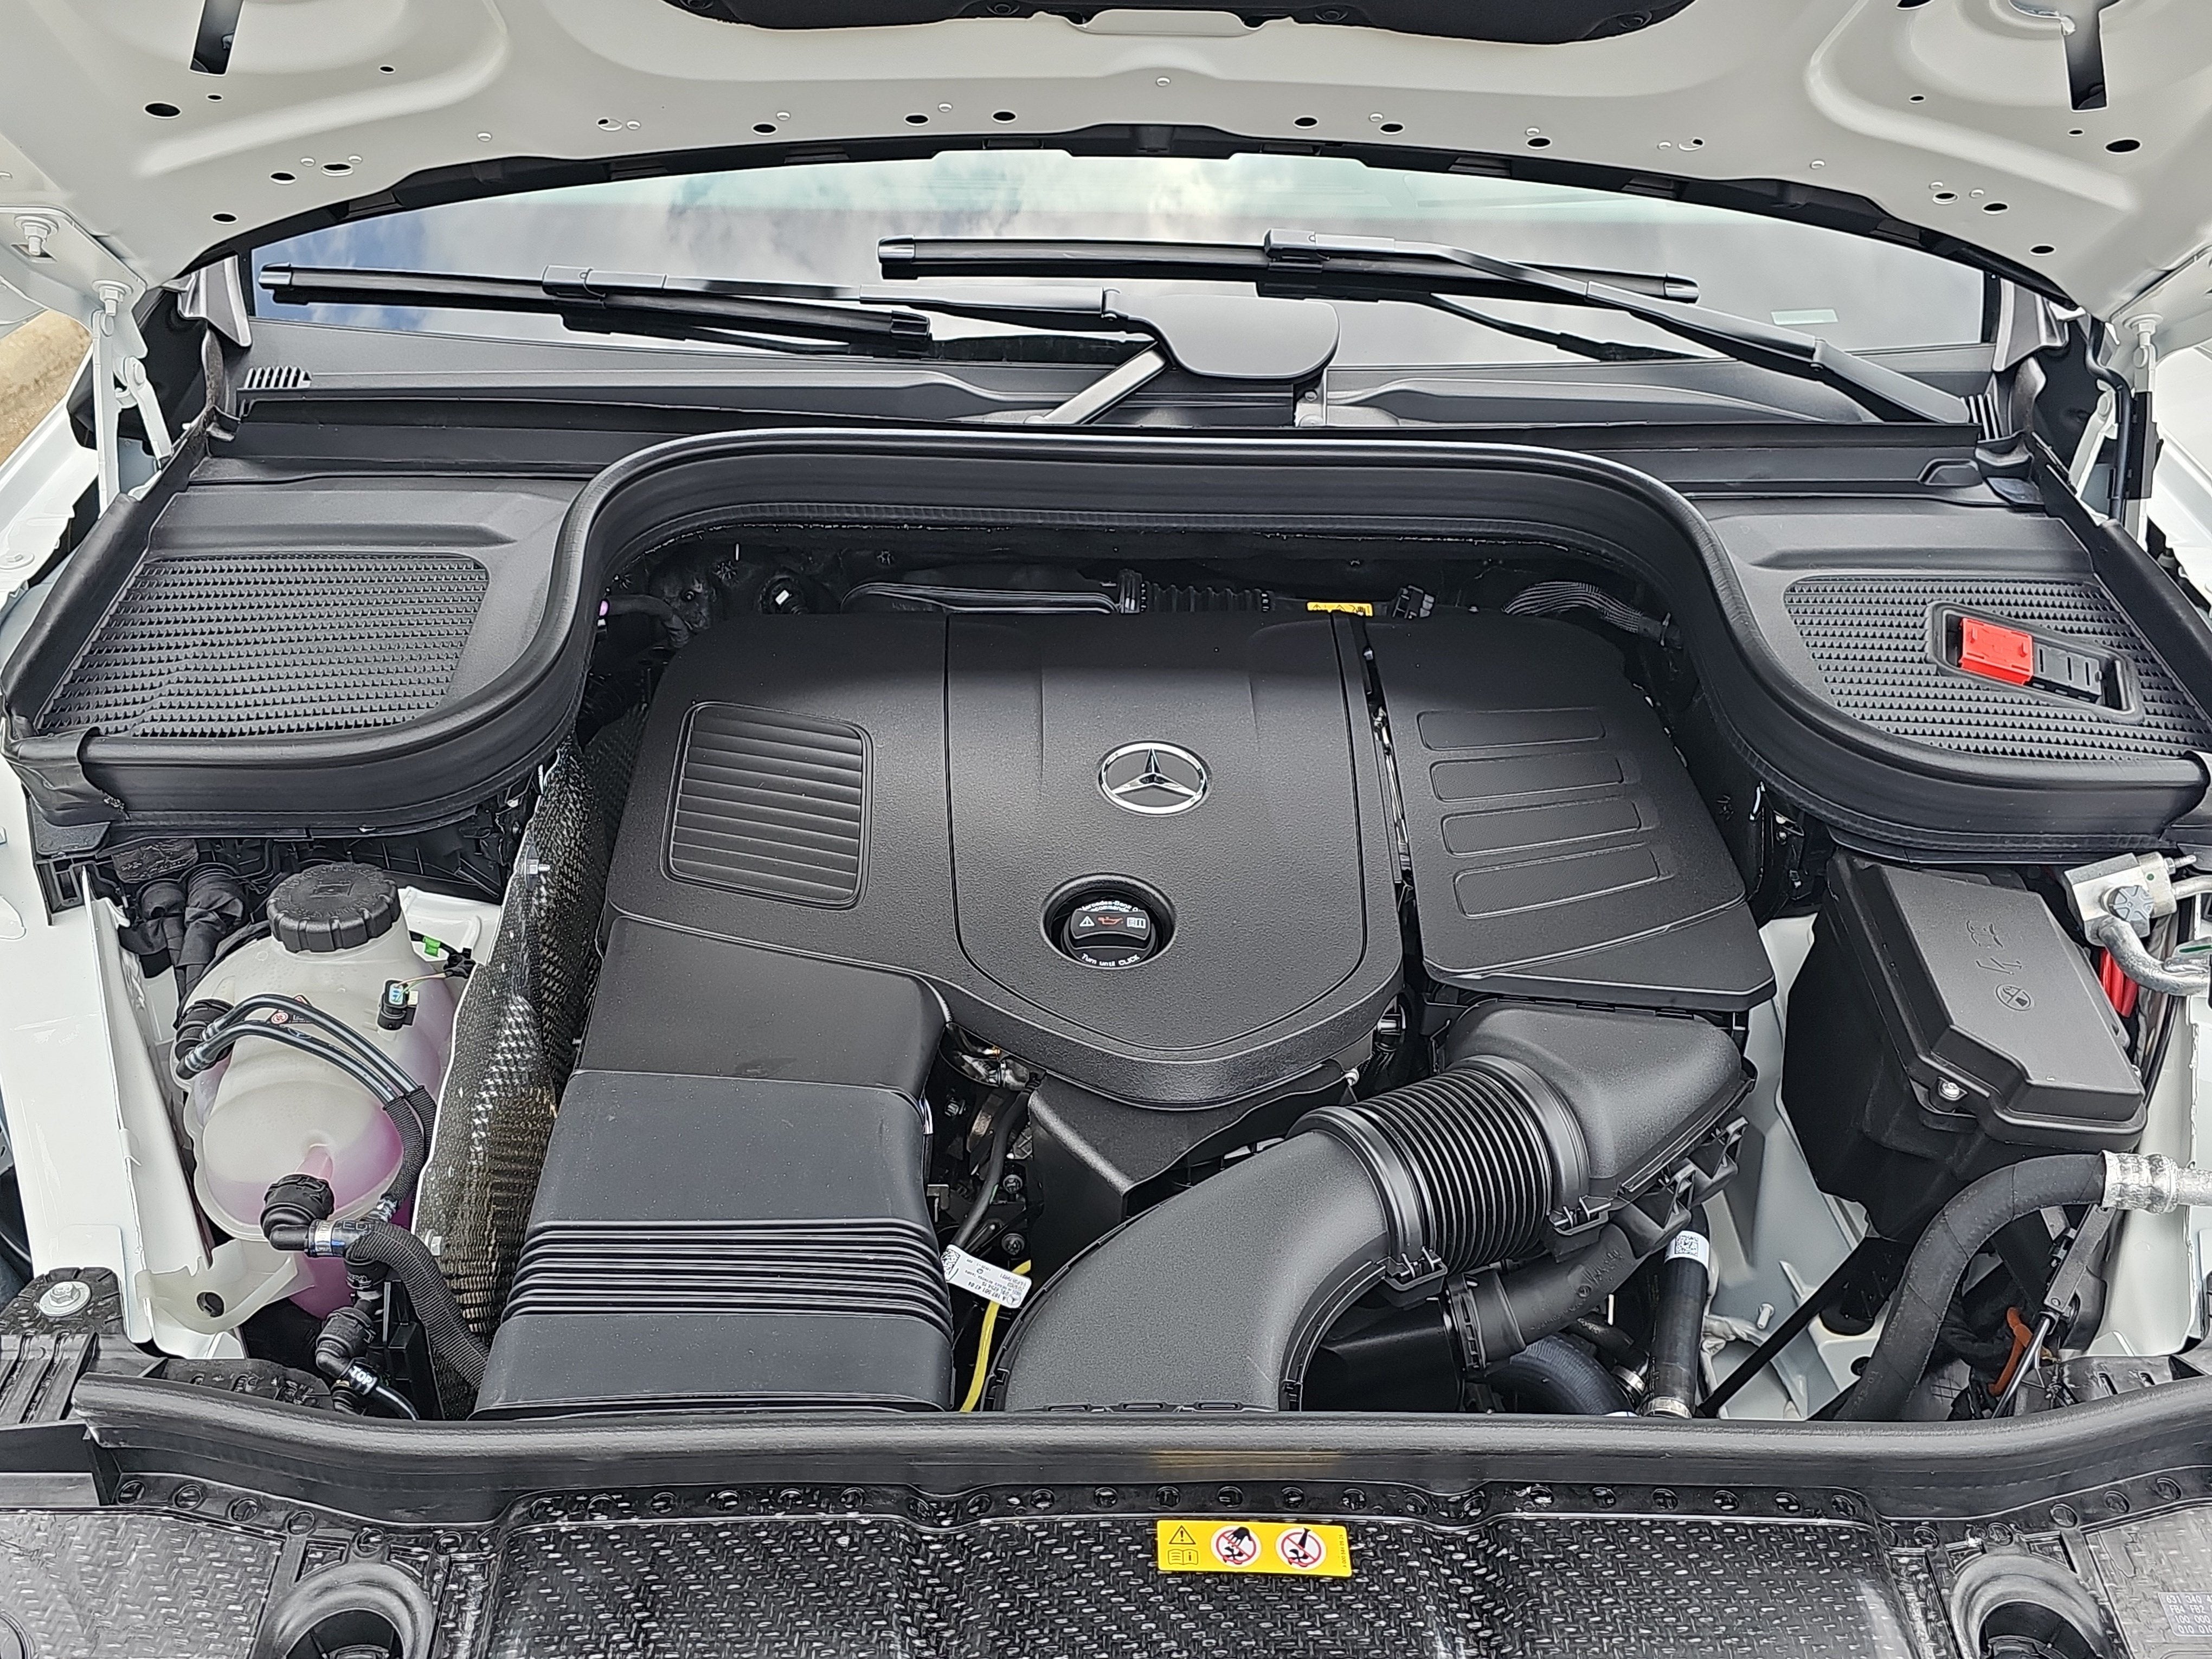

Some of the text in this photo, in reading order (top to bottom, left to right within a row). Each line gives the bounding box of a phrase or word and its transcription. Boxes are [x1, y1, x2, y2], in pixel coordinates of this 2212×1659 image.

[1082, 953, 1097, 964] Turn
[1118, 954, 1140, 965] CLICK
[351, 1365, 373, 1385] TOP
[2166, 1595, 2182, 1603] 631
[2185, 1595, 2202, 1603] 340
[2169, 1604, 2207, 1613] FB4 FB2
[2174, 1615, 2210, 1624] 100 000
[2178, 1624, 2195, 1634] 010
